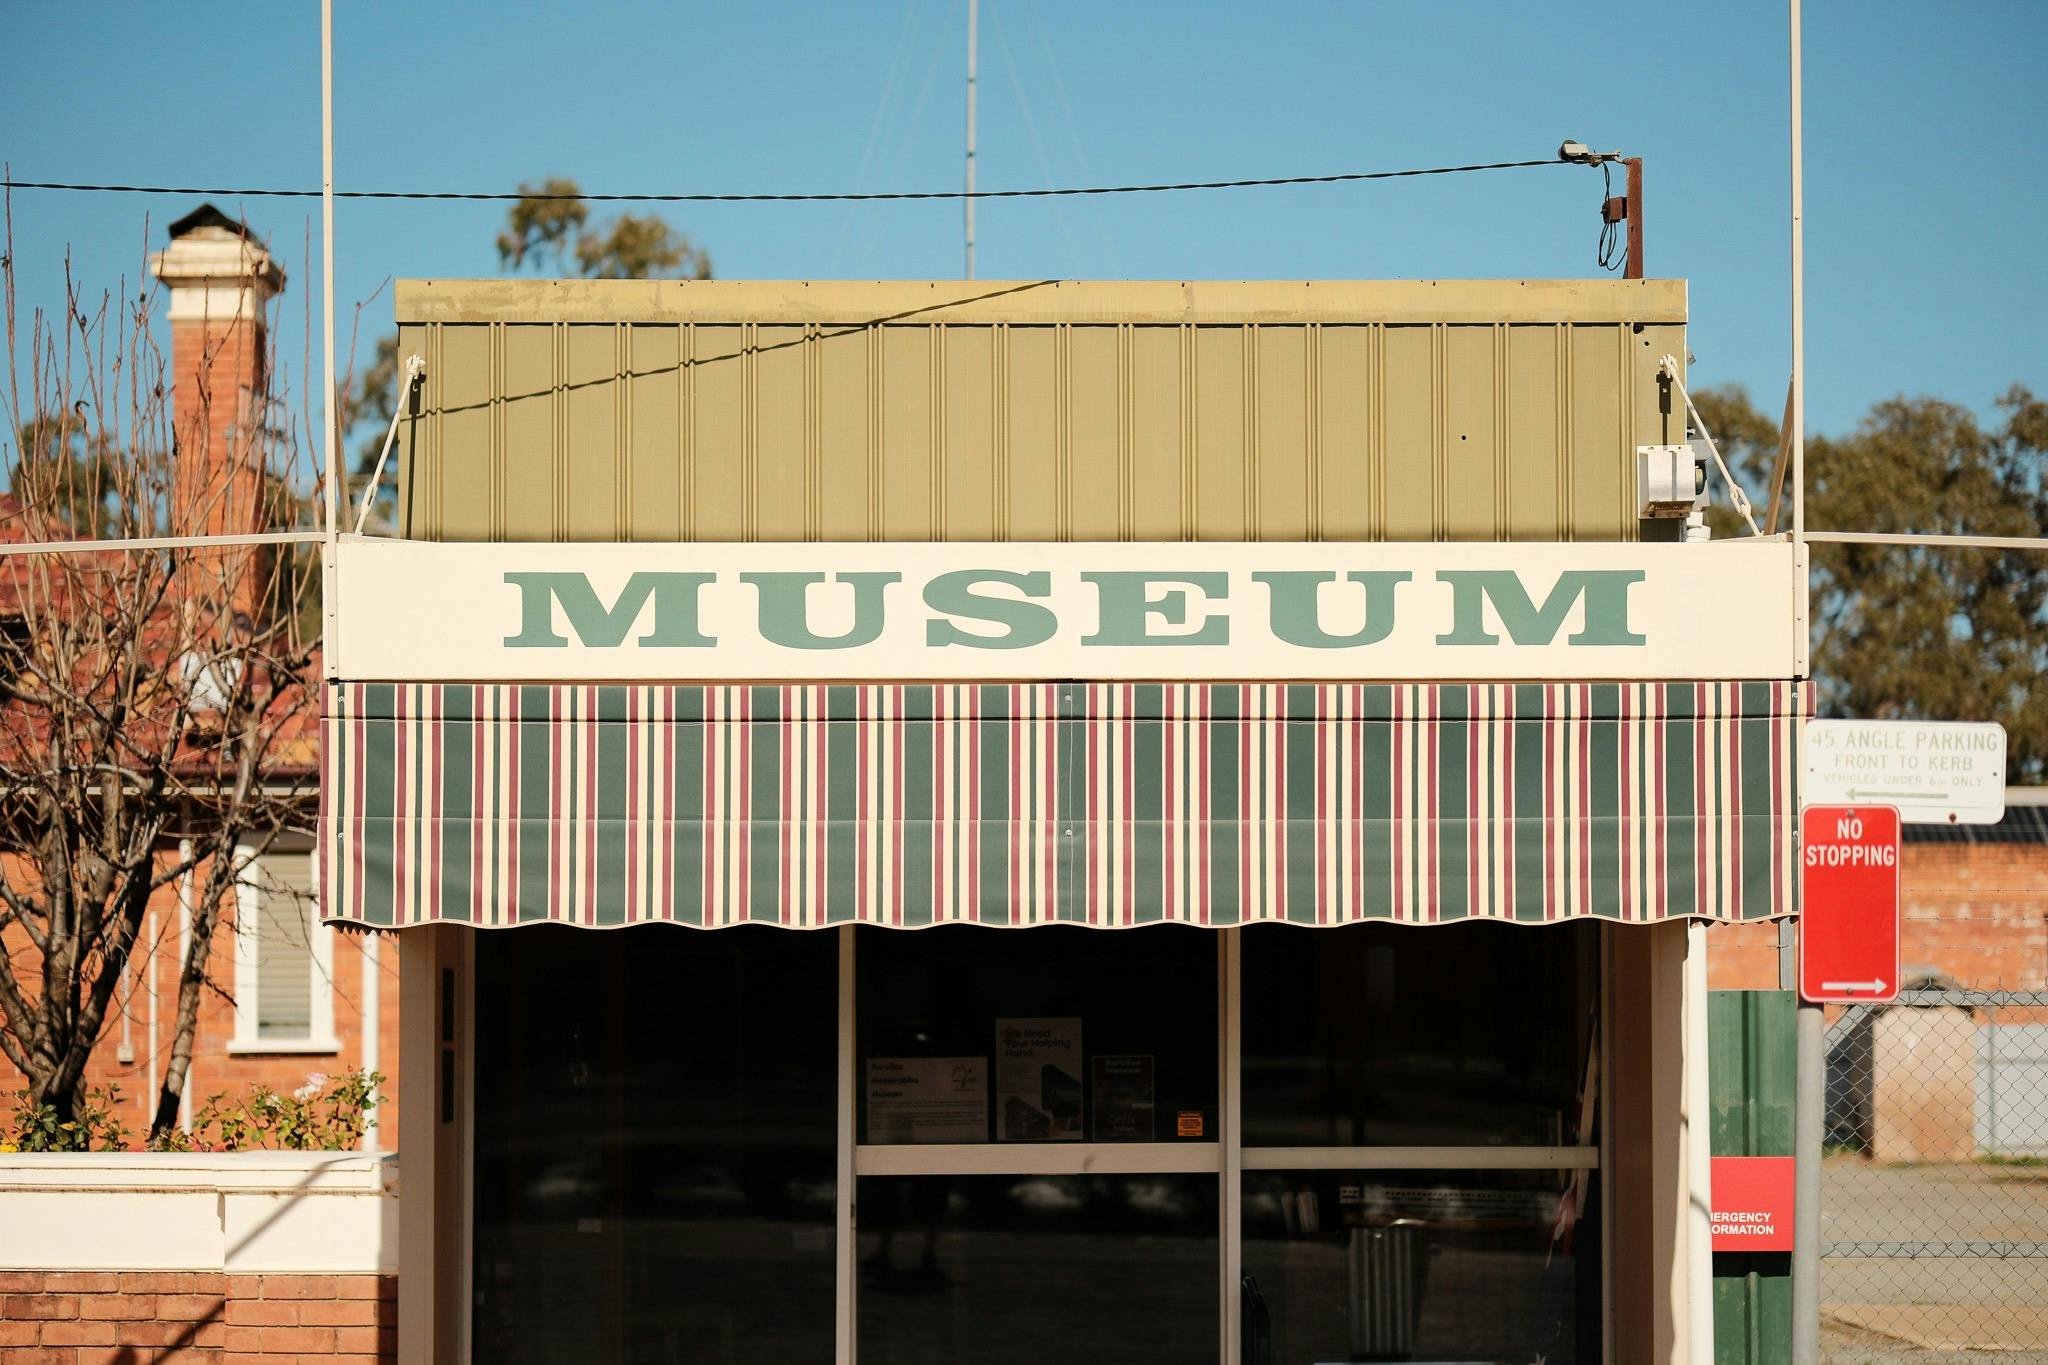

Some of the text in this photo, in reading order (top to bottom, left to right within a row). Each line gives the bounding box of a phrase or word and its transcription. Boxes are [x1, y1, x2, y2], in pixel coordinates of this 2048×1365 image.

[503, 569, 1646, 650] MUSEUM
[1846, 730, 1905, 749] ANGLE
[1916, 731, 1998, 751] PARKING
[1835, 754, 1974, 771] FRONT TO KERB
[1824, 774, 1878, 785] VEHICLES
[1884, 774, 1922, 786] UNDER
[1952, 776, 1984, 787] ONLY
[1836, 818, 1863, 840] NO
[1805, 845, 1896, 867] STOPPING
[1031, 1039, 1071, 1049] Helping
